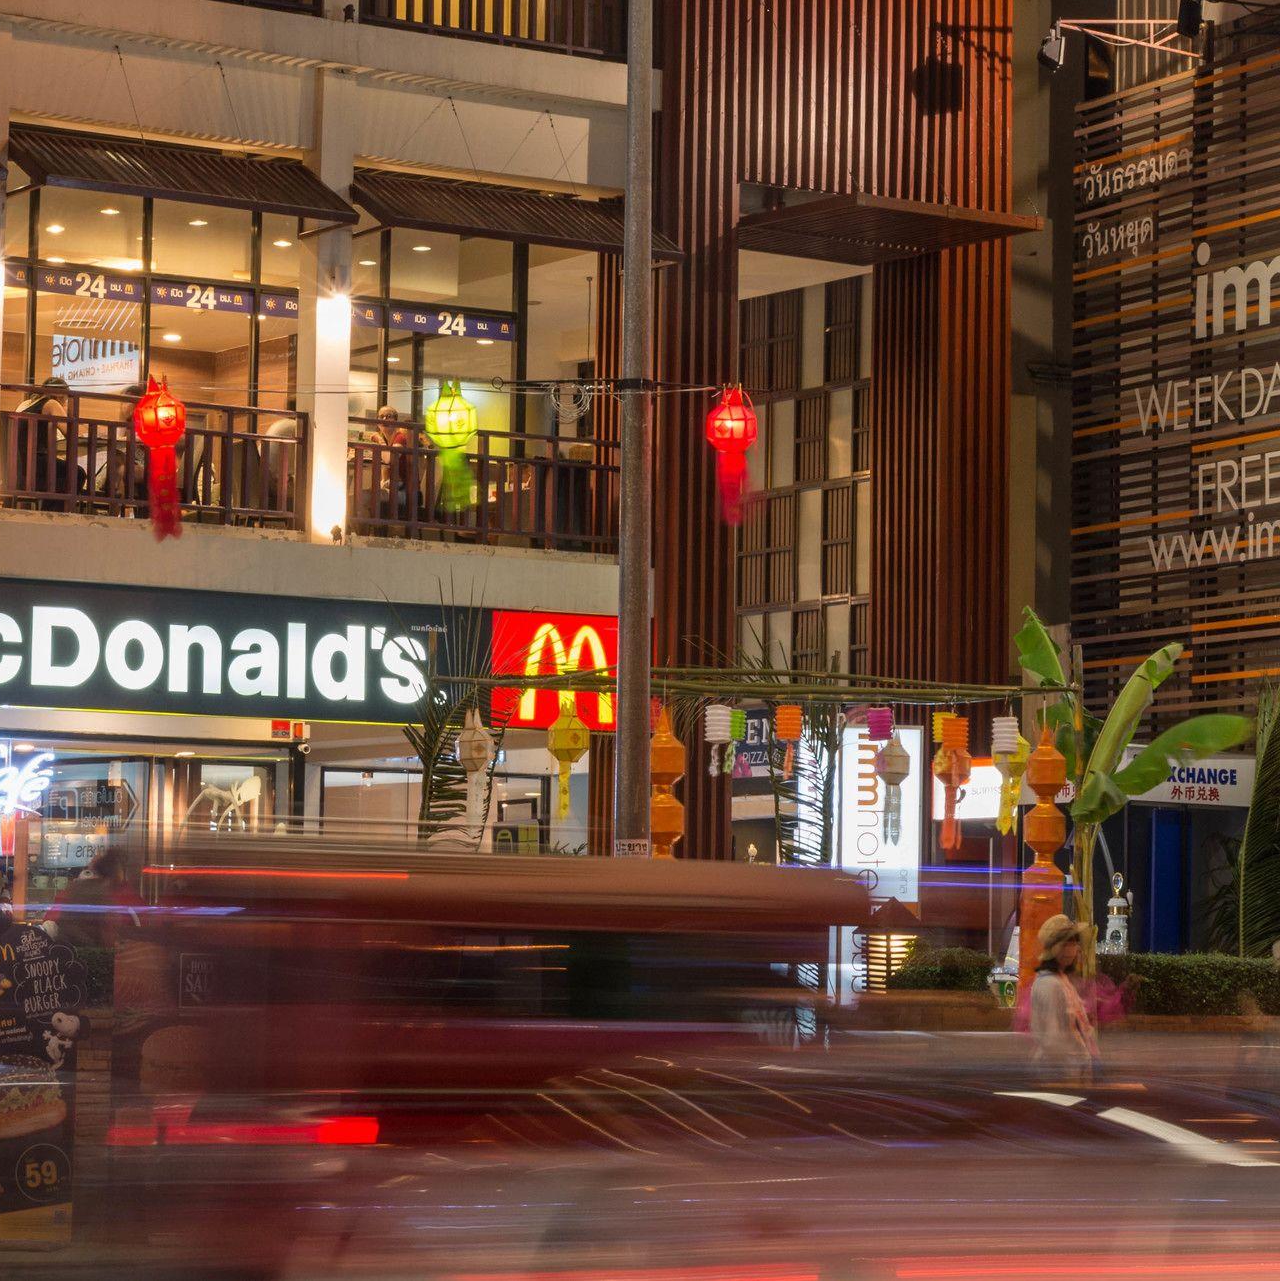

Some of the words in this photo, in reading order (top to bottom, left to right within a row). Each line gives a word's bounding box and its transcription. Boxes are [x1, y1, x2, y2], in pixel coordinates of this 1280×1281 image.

[75, 272, 107, 299] 24
[186, 284, 217, 310] 24
[437, 311, 467, 337] 24
[742, 750, 770, 764] PIZZA
[1167, 765, 1237, 786] XCHANGE
[1171, 785, 1220, 802] 外币兑换
[24, 958, 60, 979] SNOOPY
[33, 973, 67, 995] BLACK
[24, 993, 61, 1013] BURGER
